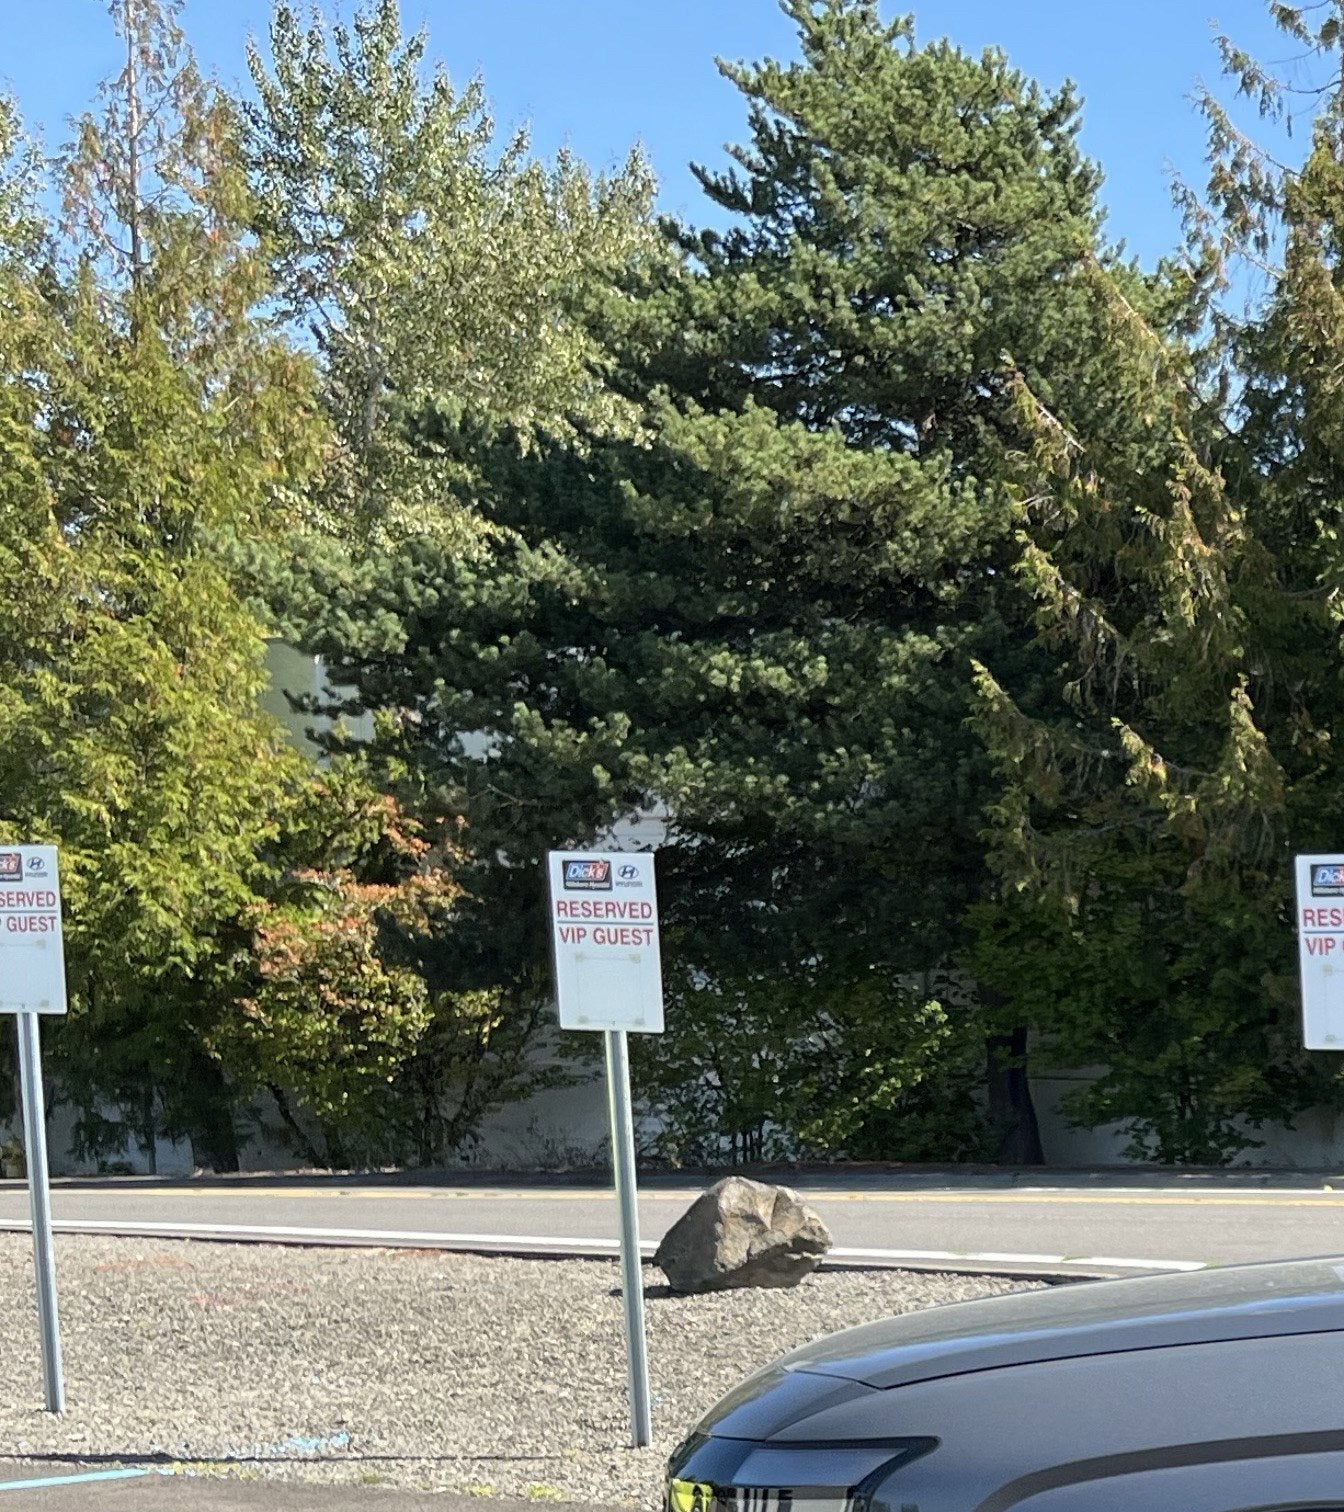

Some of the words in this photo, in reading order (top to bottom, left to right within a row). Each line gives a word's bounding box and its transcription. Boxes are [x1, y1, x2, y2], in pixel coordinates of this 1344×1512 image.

[0, 891, 56, 908] SERVED
[557, 901, 652, 919] RESERVED
[7, 916, 57, 932] GUEST
[559, 927, 587, 944] VIP
[592, 927, 654, 945] GUEST
[1305, 938, 1336, 955] VIP
